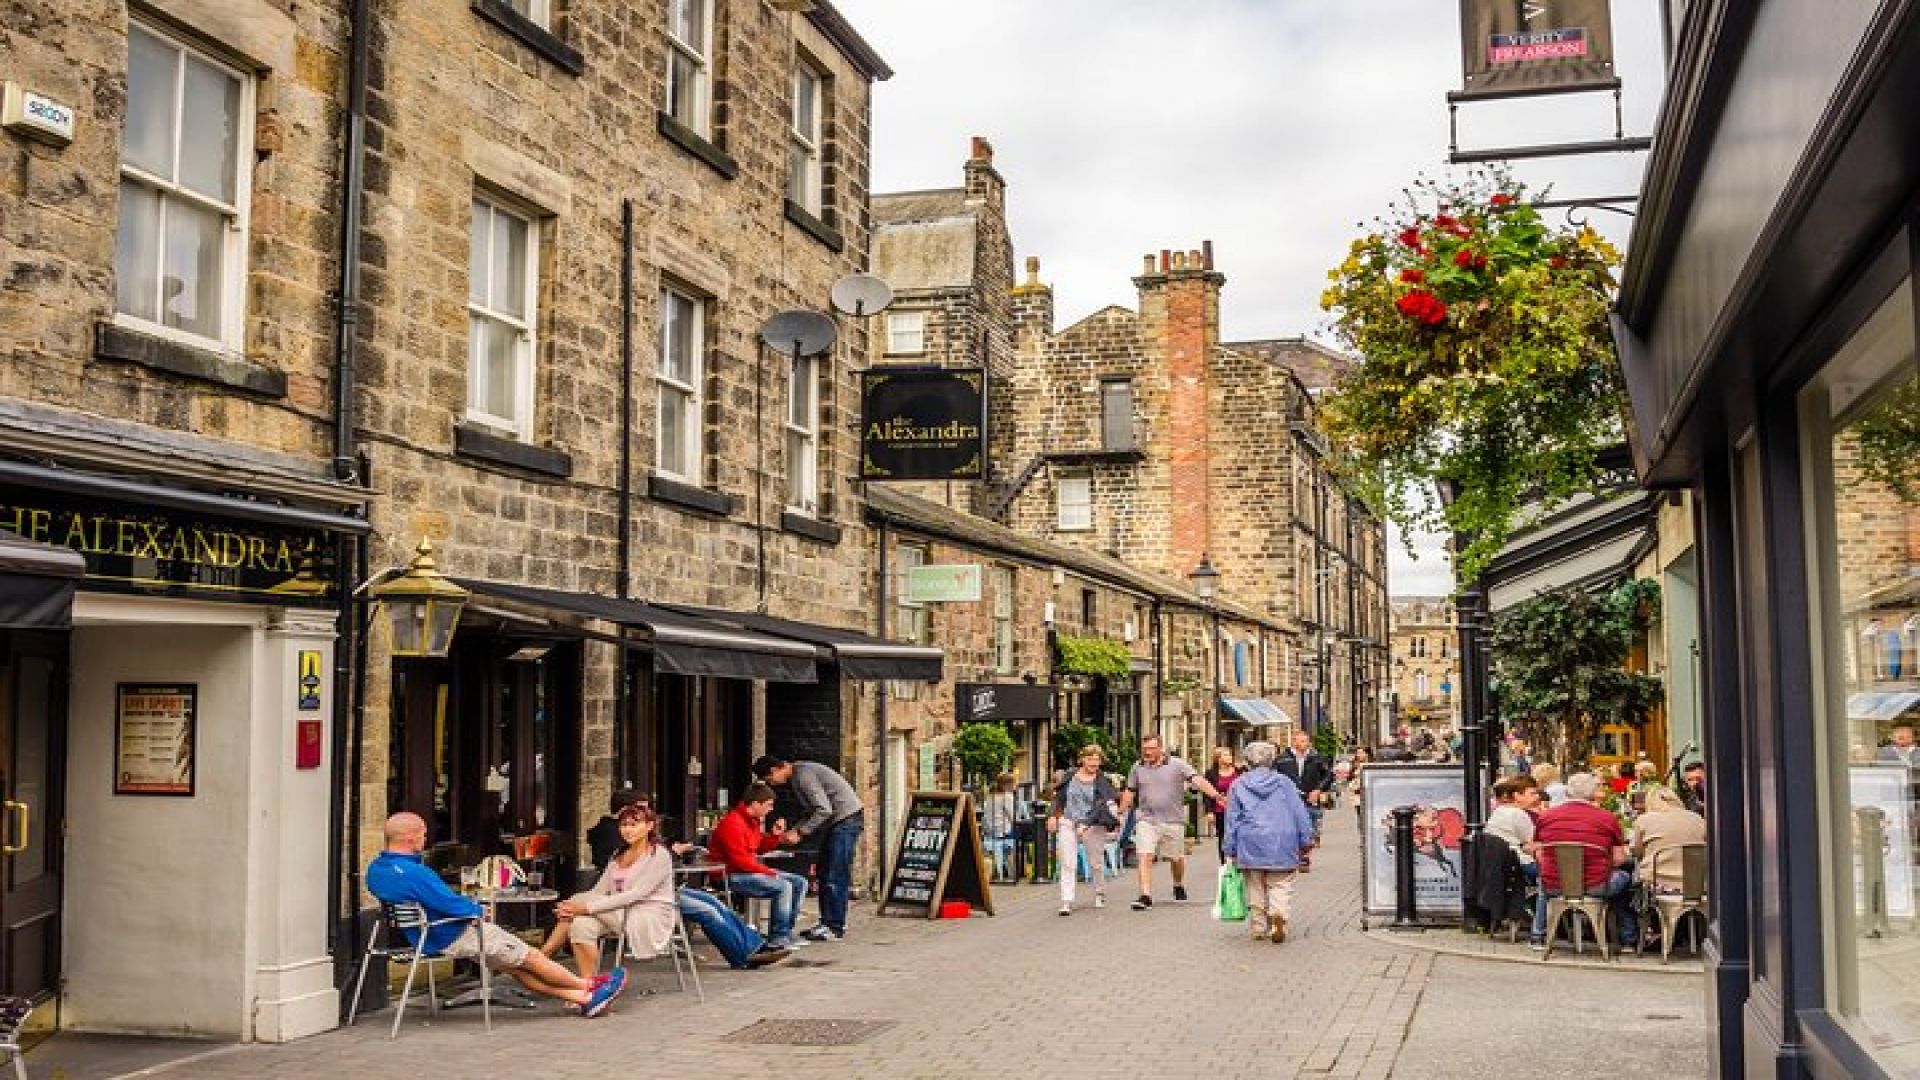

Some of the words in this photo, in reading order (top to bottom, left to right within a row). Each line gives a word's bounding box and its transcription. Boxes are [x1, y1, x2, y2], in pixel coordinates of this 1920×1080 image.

[1508, 31, 1563, 46] VERITY
[1495, 42, 1580, 60] FREARSON
[893, 414, 912, 426] the
[866, 421, 979, 440] Alexandra
[0, 505, 52, 552] HE
[64, 511, 293, 573] ALEXANDRA
